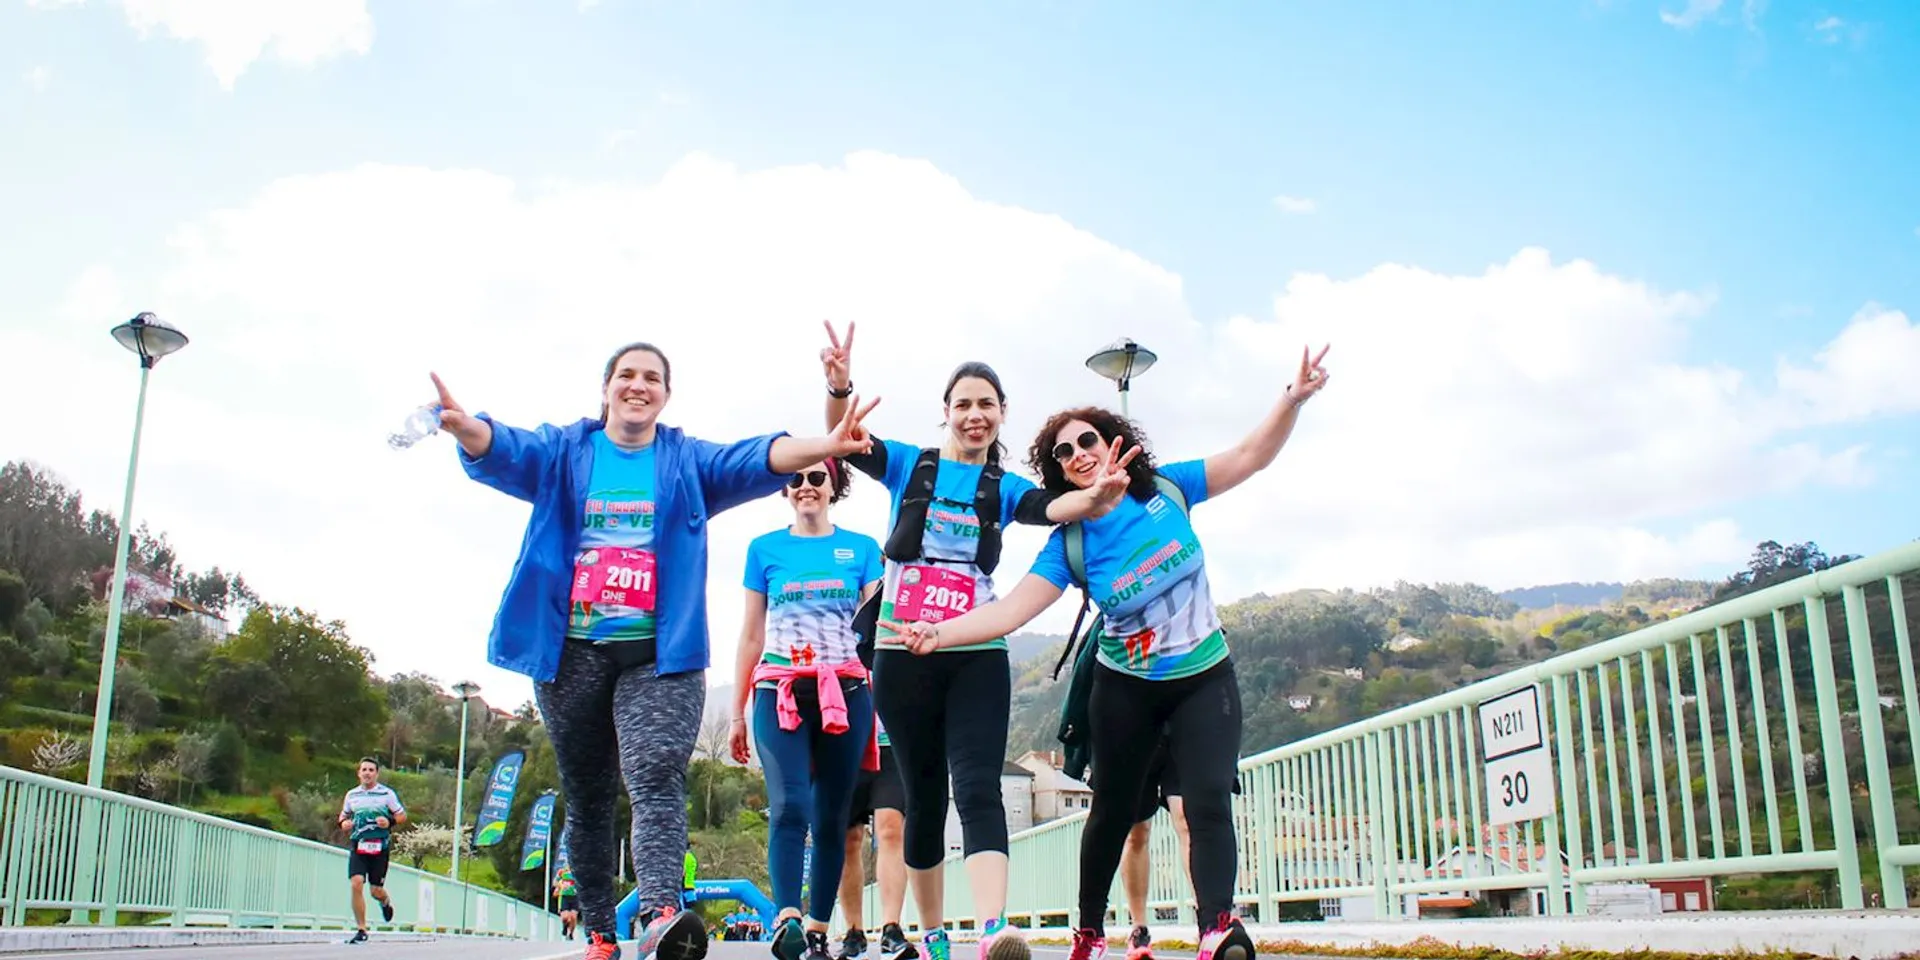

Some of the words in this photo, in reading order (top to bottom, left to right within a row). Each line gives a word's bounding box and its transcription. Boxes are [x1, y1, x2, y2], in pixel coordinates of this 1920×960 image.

[584, 499, 603, 514] EIA
[604, 500, 656, 514] MARATON
[629, 513, 653, 528] VE
[952, 521, 983, 538] VER
[605, 565, 652, 592] 2011
[922, 585, 969, 613] 2012
[1492, 709, 1524, 740] N211
[1502, 771, 1528, 807] 30
